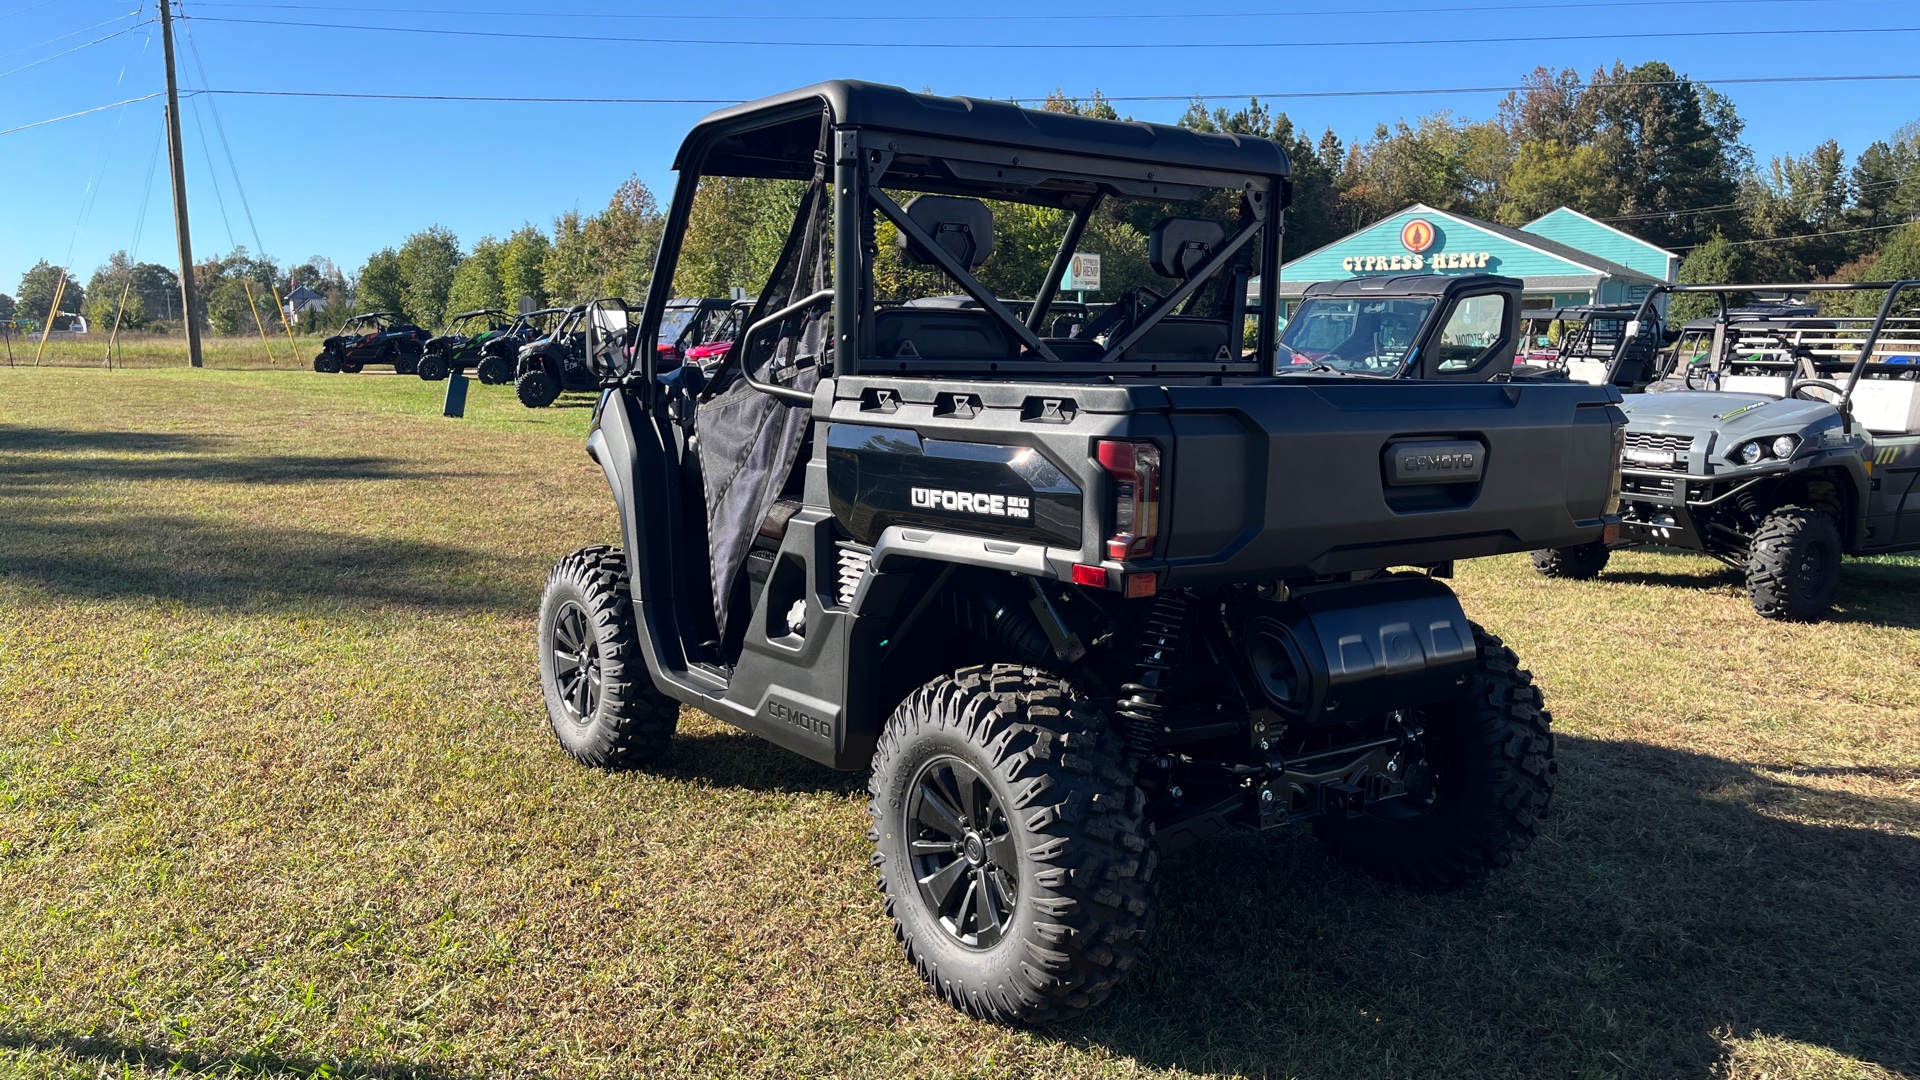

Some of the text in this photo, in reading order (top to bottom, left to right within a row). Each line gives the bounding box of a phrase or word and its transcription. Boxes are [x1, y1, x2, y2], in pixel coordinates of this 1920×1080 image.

[1342, 252, 1490, 271] CYPRESS HEMP
[1404, 453, 1474, 471] CFMOTO
[911, 487, 1005, 516] UFORCE
[1007, 507, 1029, 518] PRO
[768, 700, 832, 739] CFMOTO
